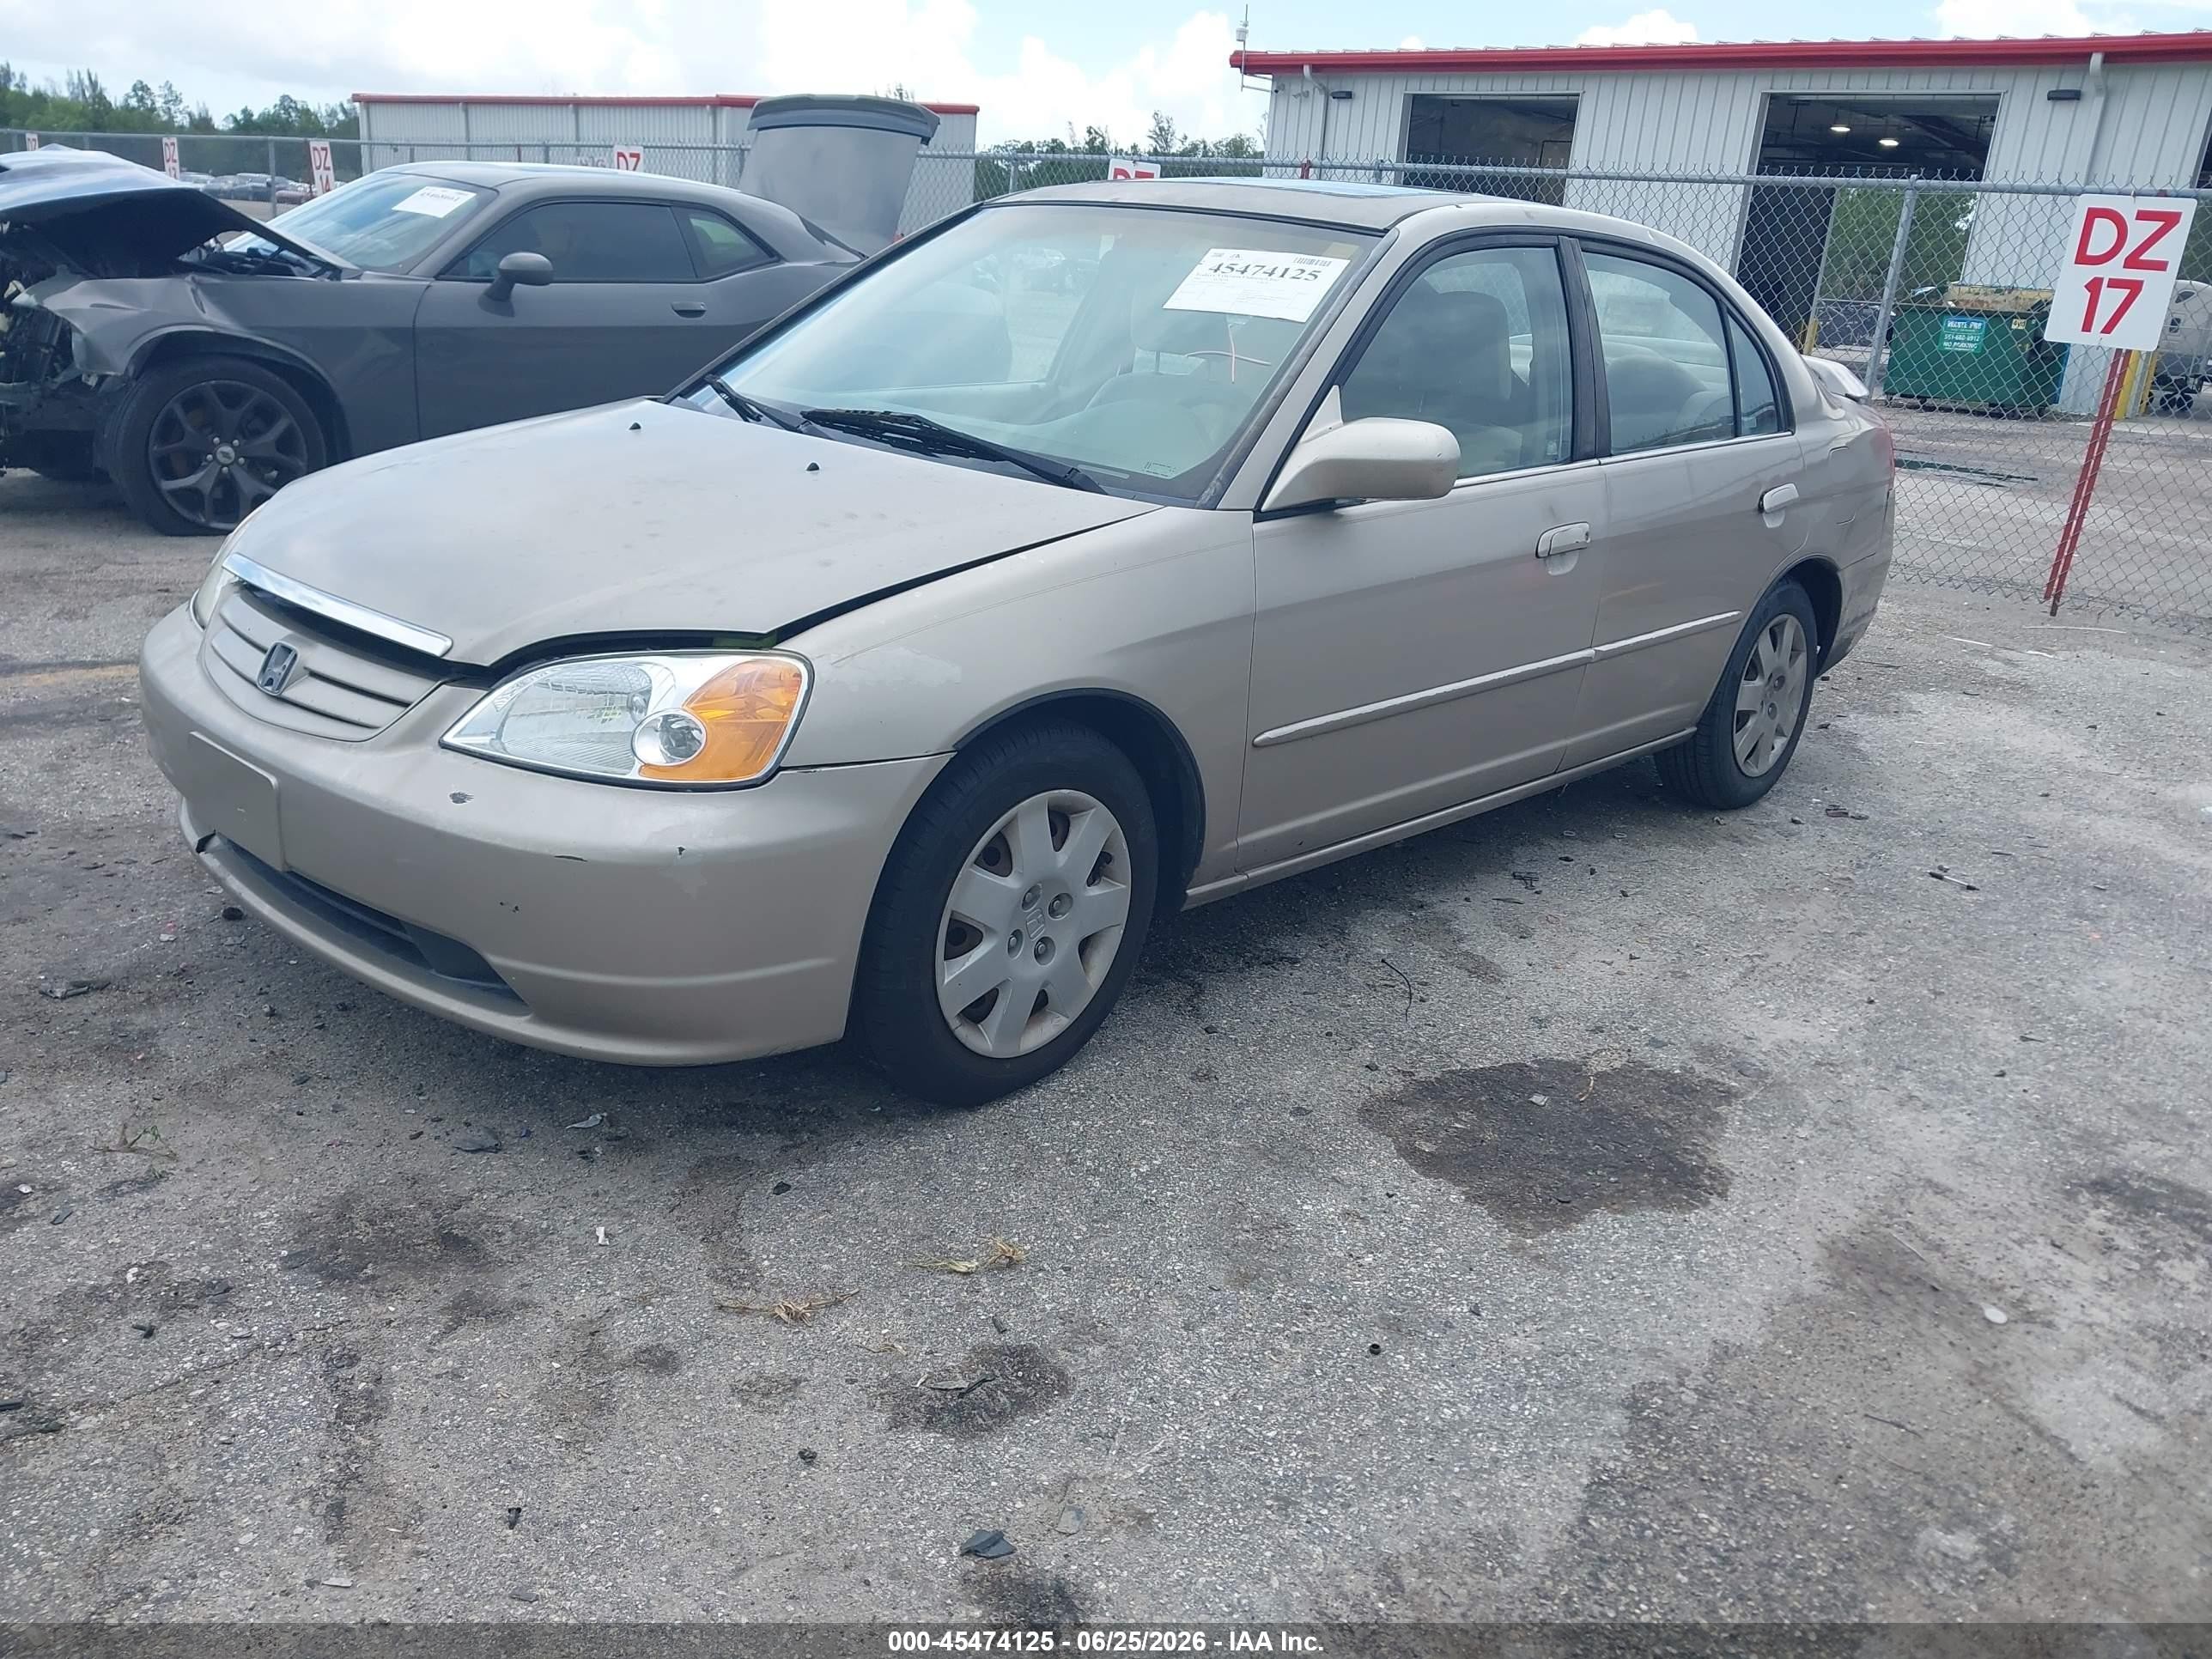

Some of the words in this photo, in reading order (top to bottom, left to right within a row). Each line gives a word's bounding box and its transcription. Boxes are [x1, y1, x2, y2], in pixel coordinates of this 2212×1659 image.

[164, 142, 177, 163] DZ
[312, 146, 331, 171] DZ
[2075, 207, 2183, 271] DZ
[1209, 263, 1322, 282] 45474125
[2081, 276, 2145, 334] 17
